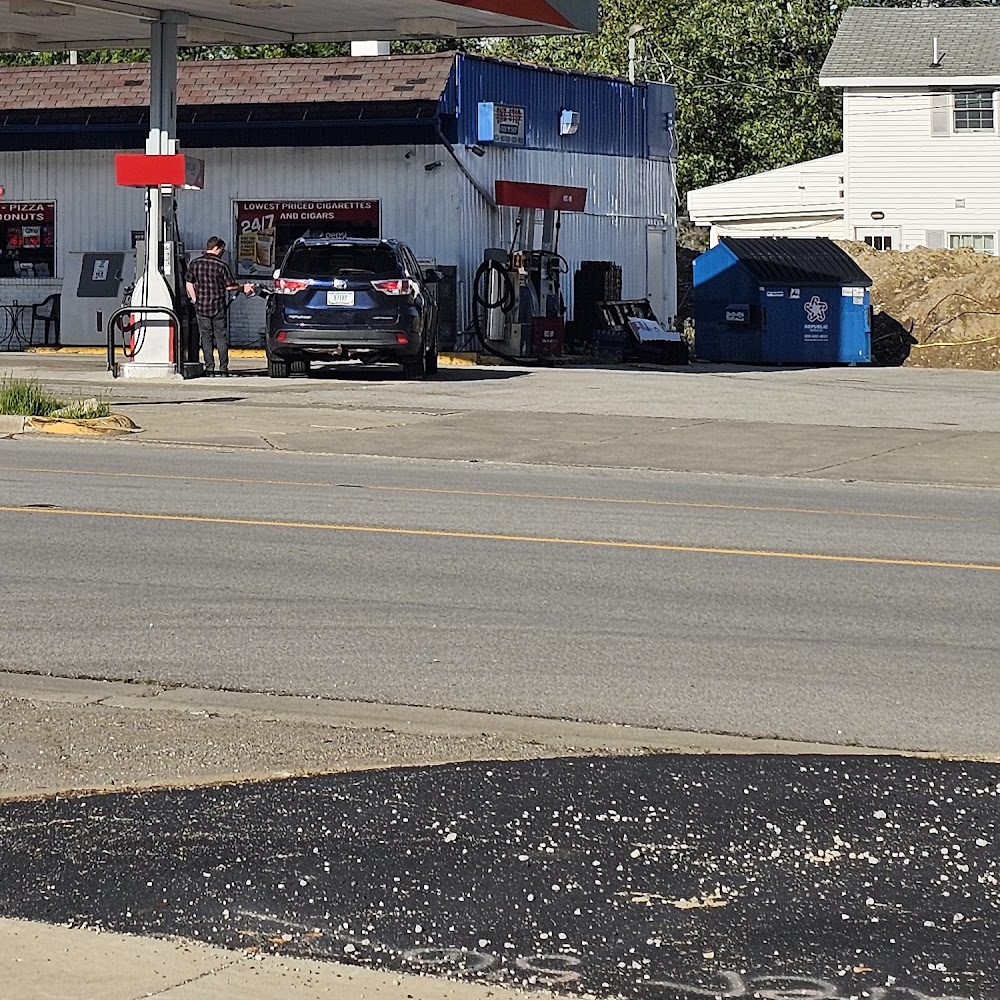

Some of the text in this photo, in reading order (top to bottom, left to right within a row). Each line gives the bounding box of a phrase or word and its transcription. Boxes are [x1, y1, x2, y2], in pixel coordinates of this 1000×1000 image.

[244, 202, 371, 211] LOWEST PRICED CIGARETTES
[280, 212, 334, 220] AND CIGARS
